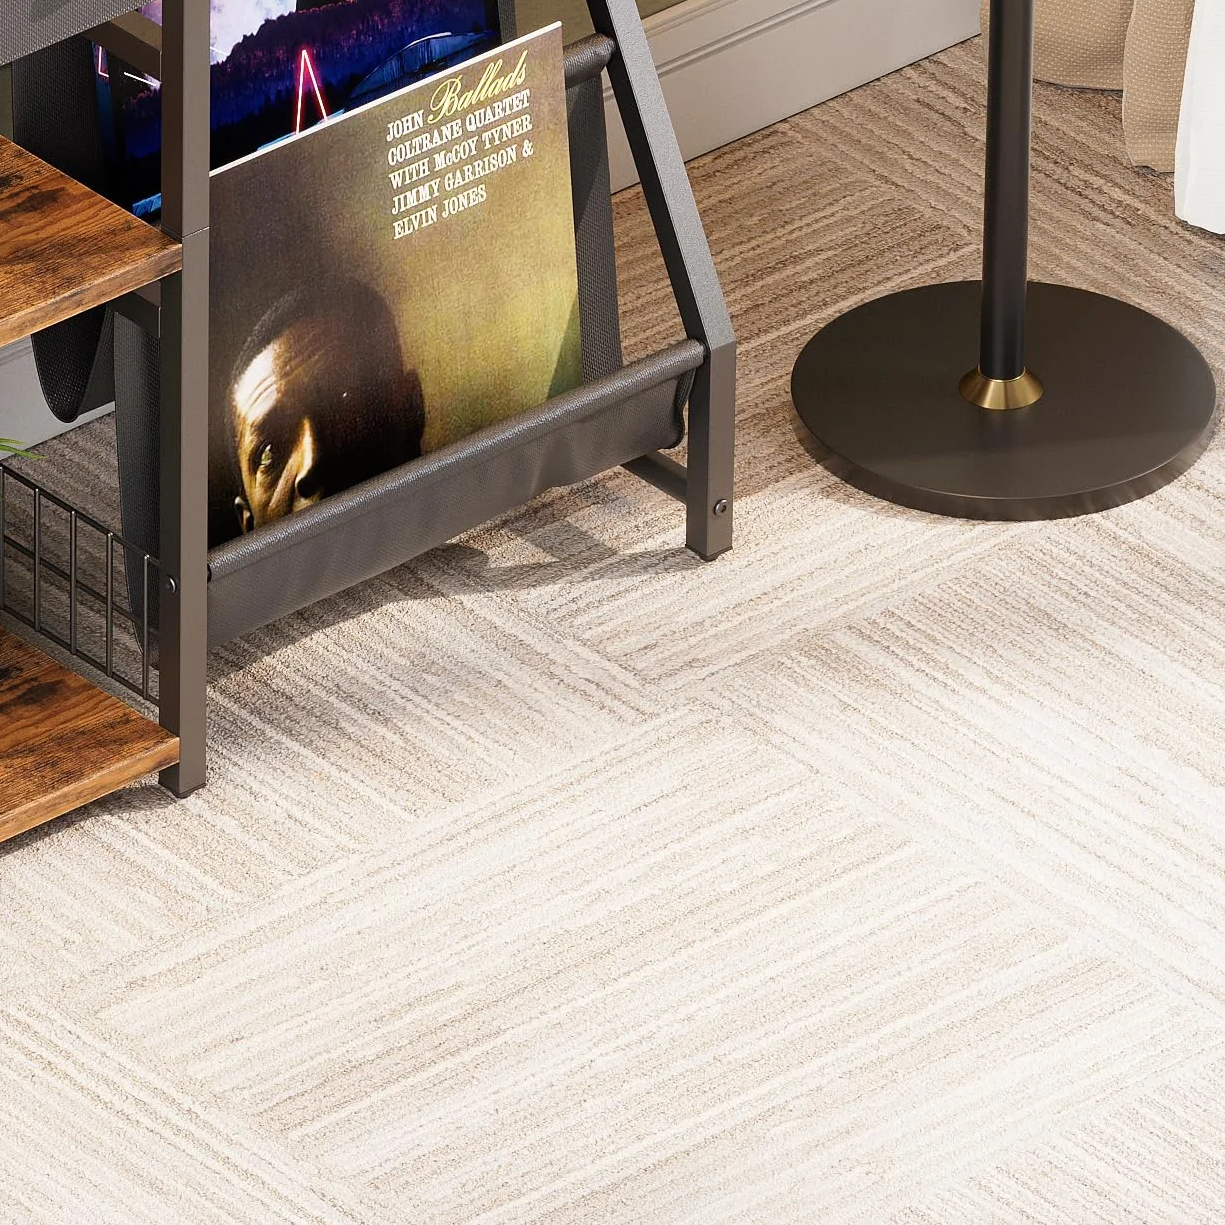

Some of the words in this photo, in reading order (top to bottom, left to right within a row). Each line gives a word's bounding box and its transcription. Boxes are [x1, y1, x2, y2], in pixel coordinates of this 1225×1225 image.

[427, 50, 528, 124] Ballads
[386, 109, 424, 142] JOHN
[387, 118, 462, 166] COLTRANE
[465, 89, 530, 132] QUARTET
[389, 157, 430, 191] WITH
[433, 135, 478, 170] McCOY
[481, 113, 533, 150] TYNER
[392, 178, 441, 215] JIMMY
[444, 144, 518, 192] GARRISON
[522, 139, 534, 158] &
[392, 204, 438, 240] ELVIN
[442, 183, 487, 219] JONES
